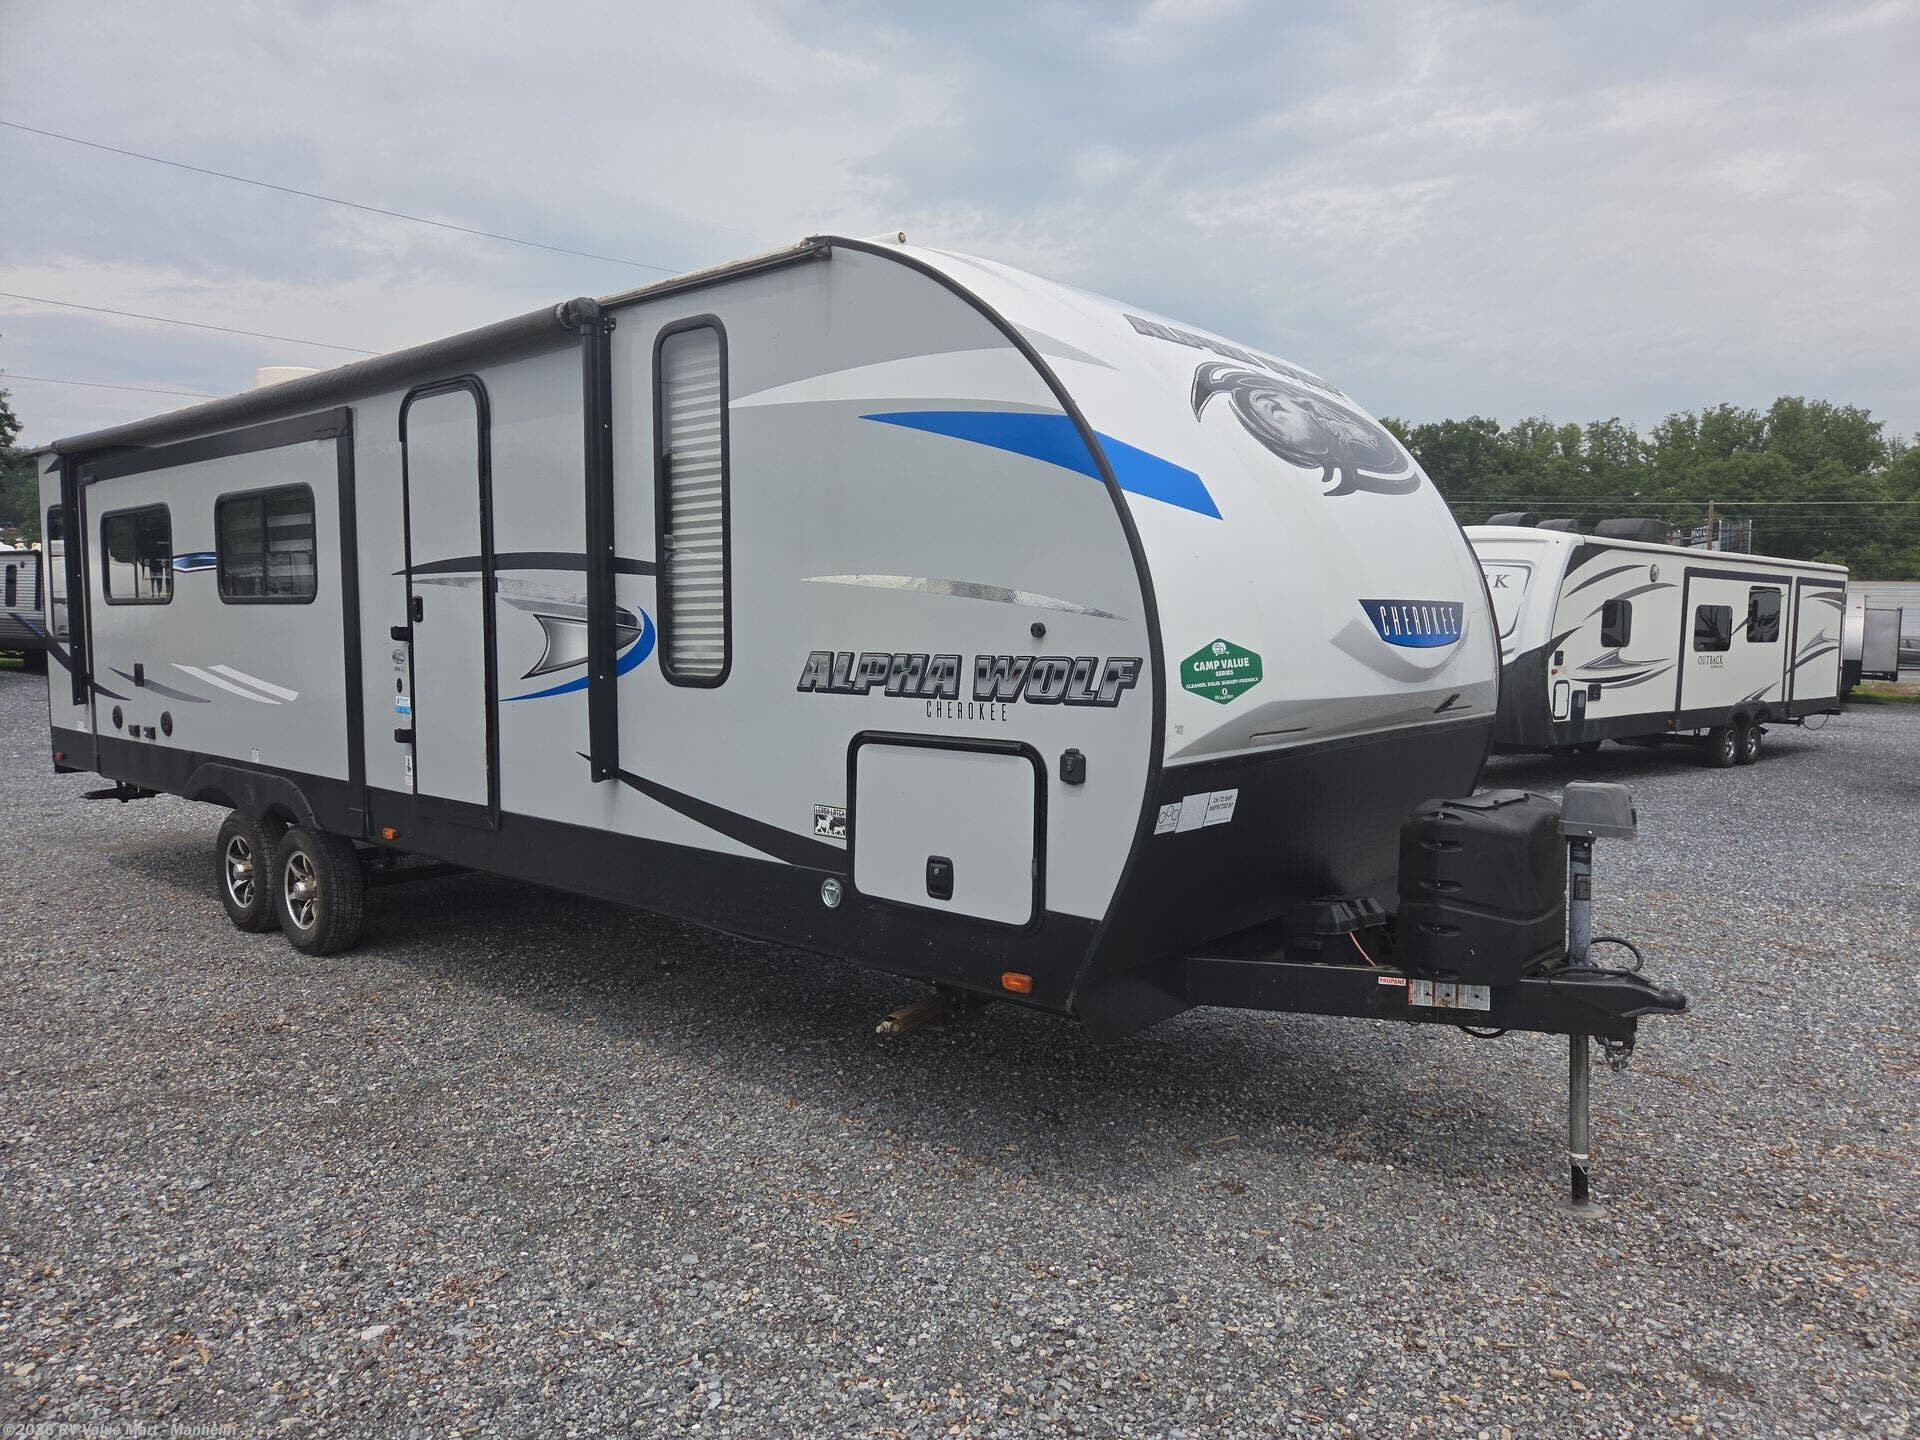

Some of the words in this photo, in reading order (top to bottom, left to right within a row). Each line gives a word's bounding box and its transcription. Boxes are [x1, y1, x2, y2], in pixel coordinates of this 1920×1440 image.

[1380, 605, 1457, 636] CHEROKEE
[1193, 660, 1220, 672] CAMP
[1220, 657, 1250, 669] VALUE
[1215, 669, 1234, 677] SERIES
[797, 650, 962, 700] ALPHA
[972, 654, 1143, 708] WOLF
[926, 700, 1008, 722] CHEROKEE
[1378, 977, 1406, 985] PROPANE
